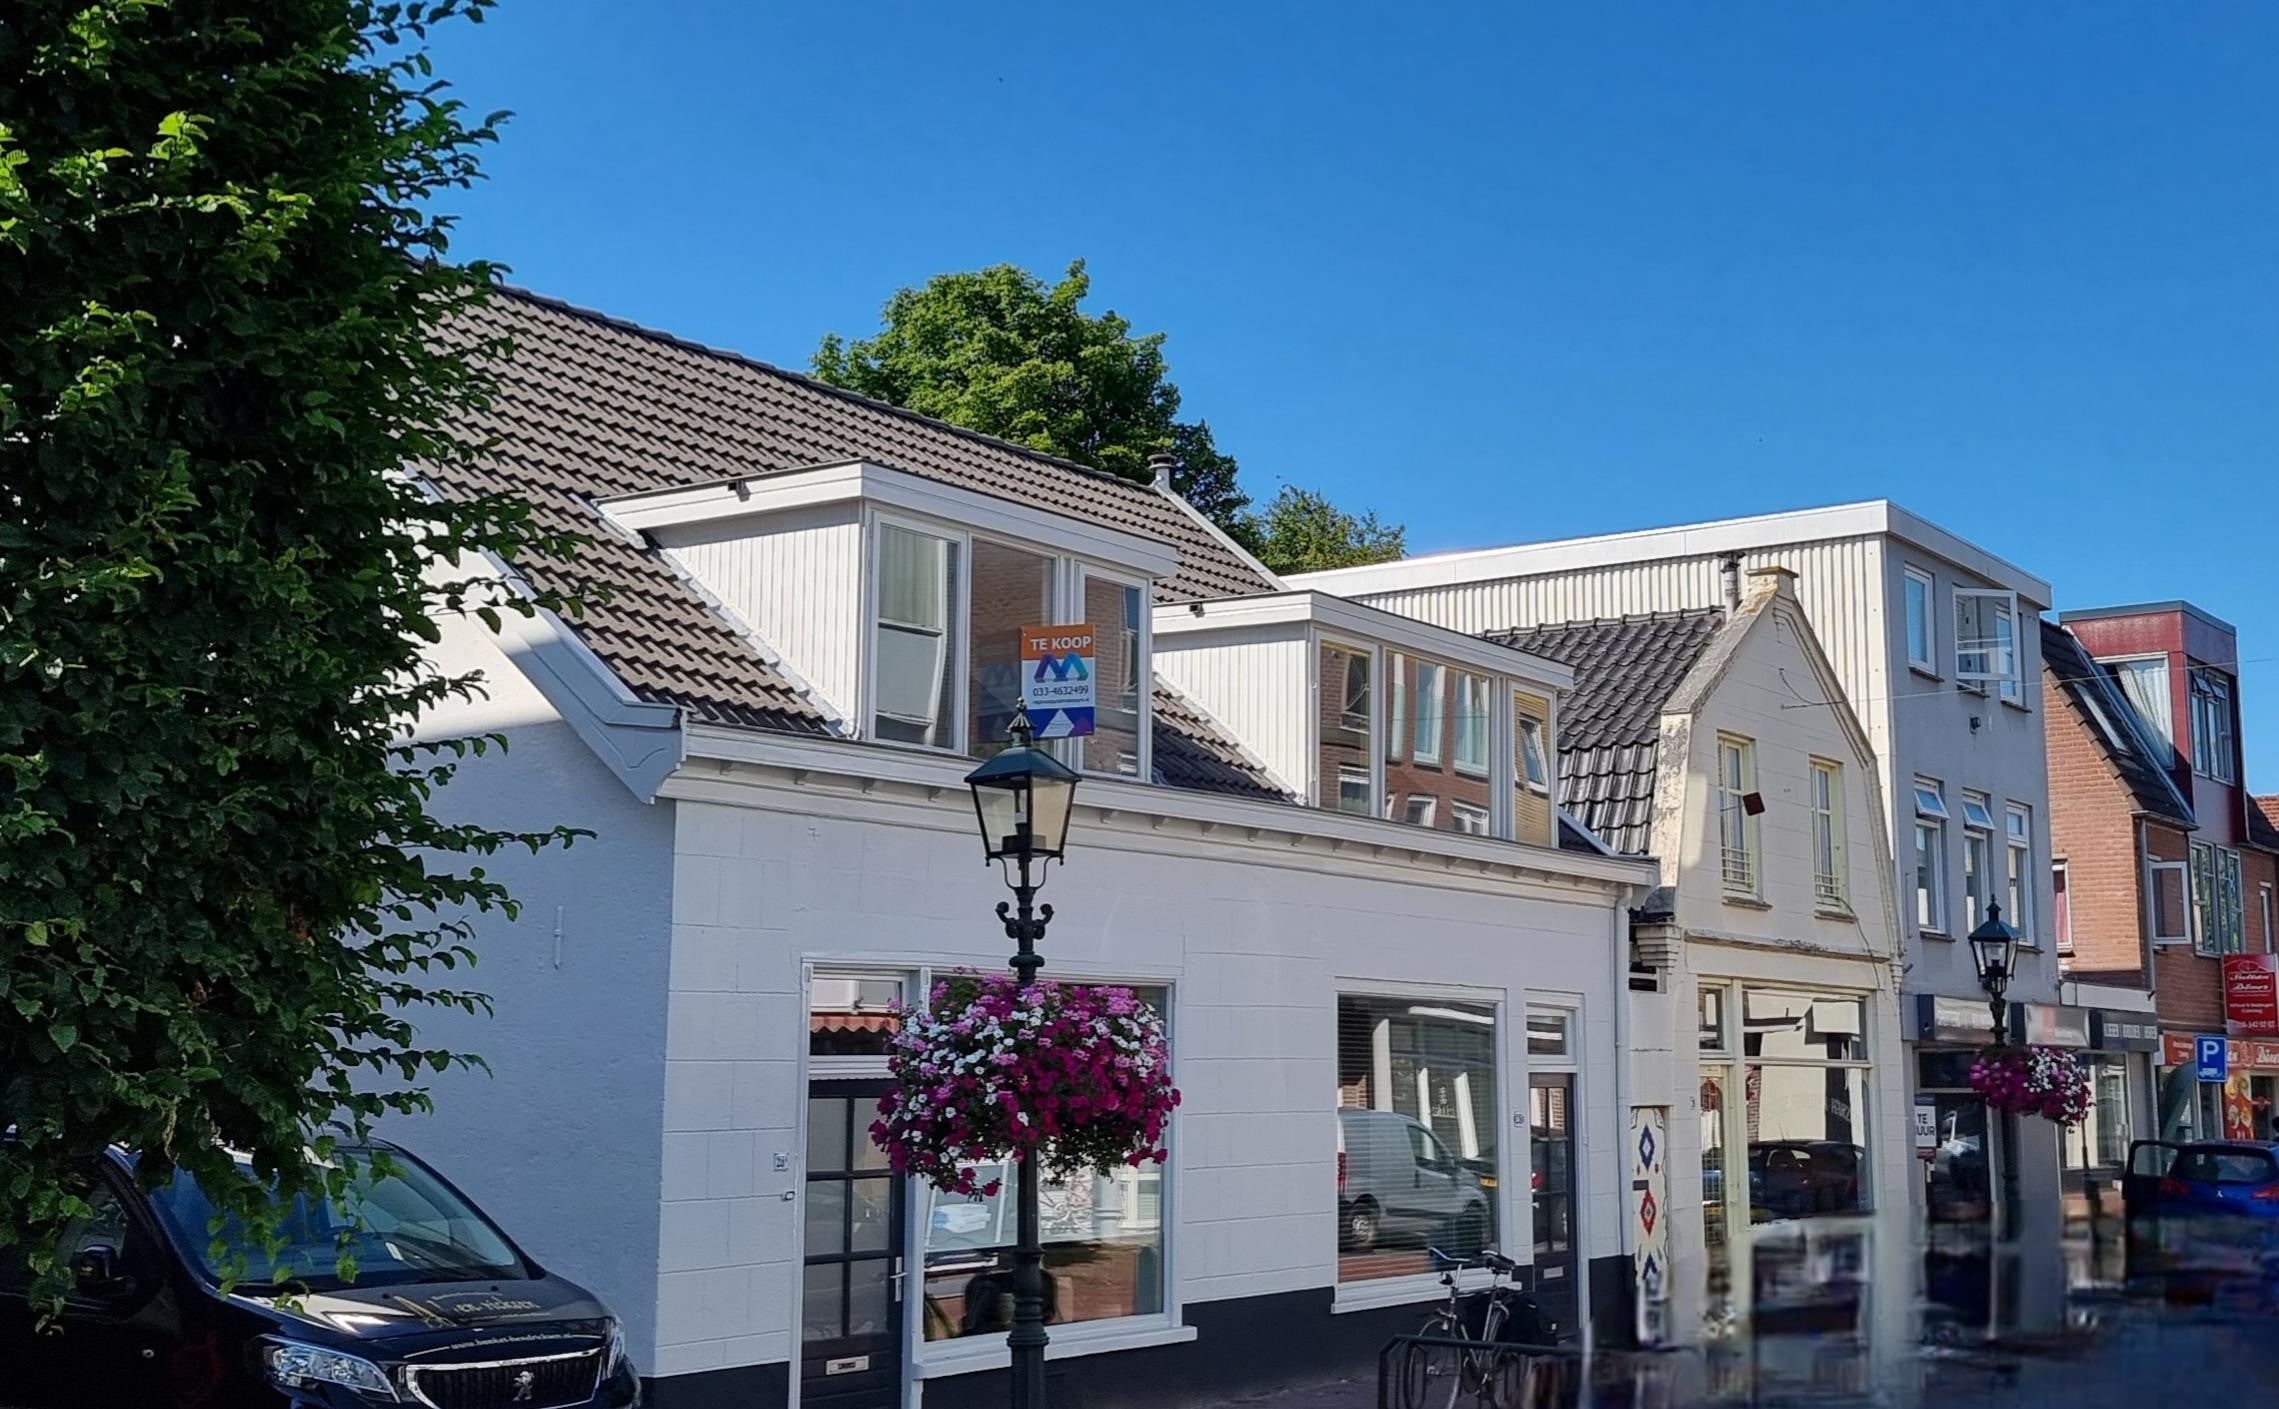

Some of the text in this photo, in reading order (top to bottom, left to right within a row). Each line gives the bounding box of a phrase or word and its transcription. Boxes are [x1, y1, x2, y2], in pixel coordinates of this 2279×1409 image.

[1030, 636, 1092, 650] TE KOOP
[2202, 1041, 2219, 1062] P
[1917, 1113, 1928, 1124] TE
[1916, 1126, 1935, 1136] UUR
